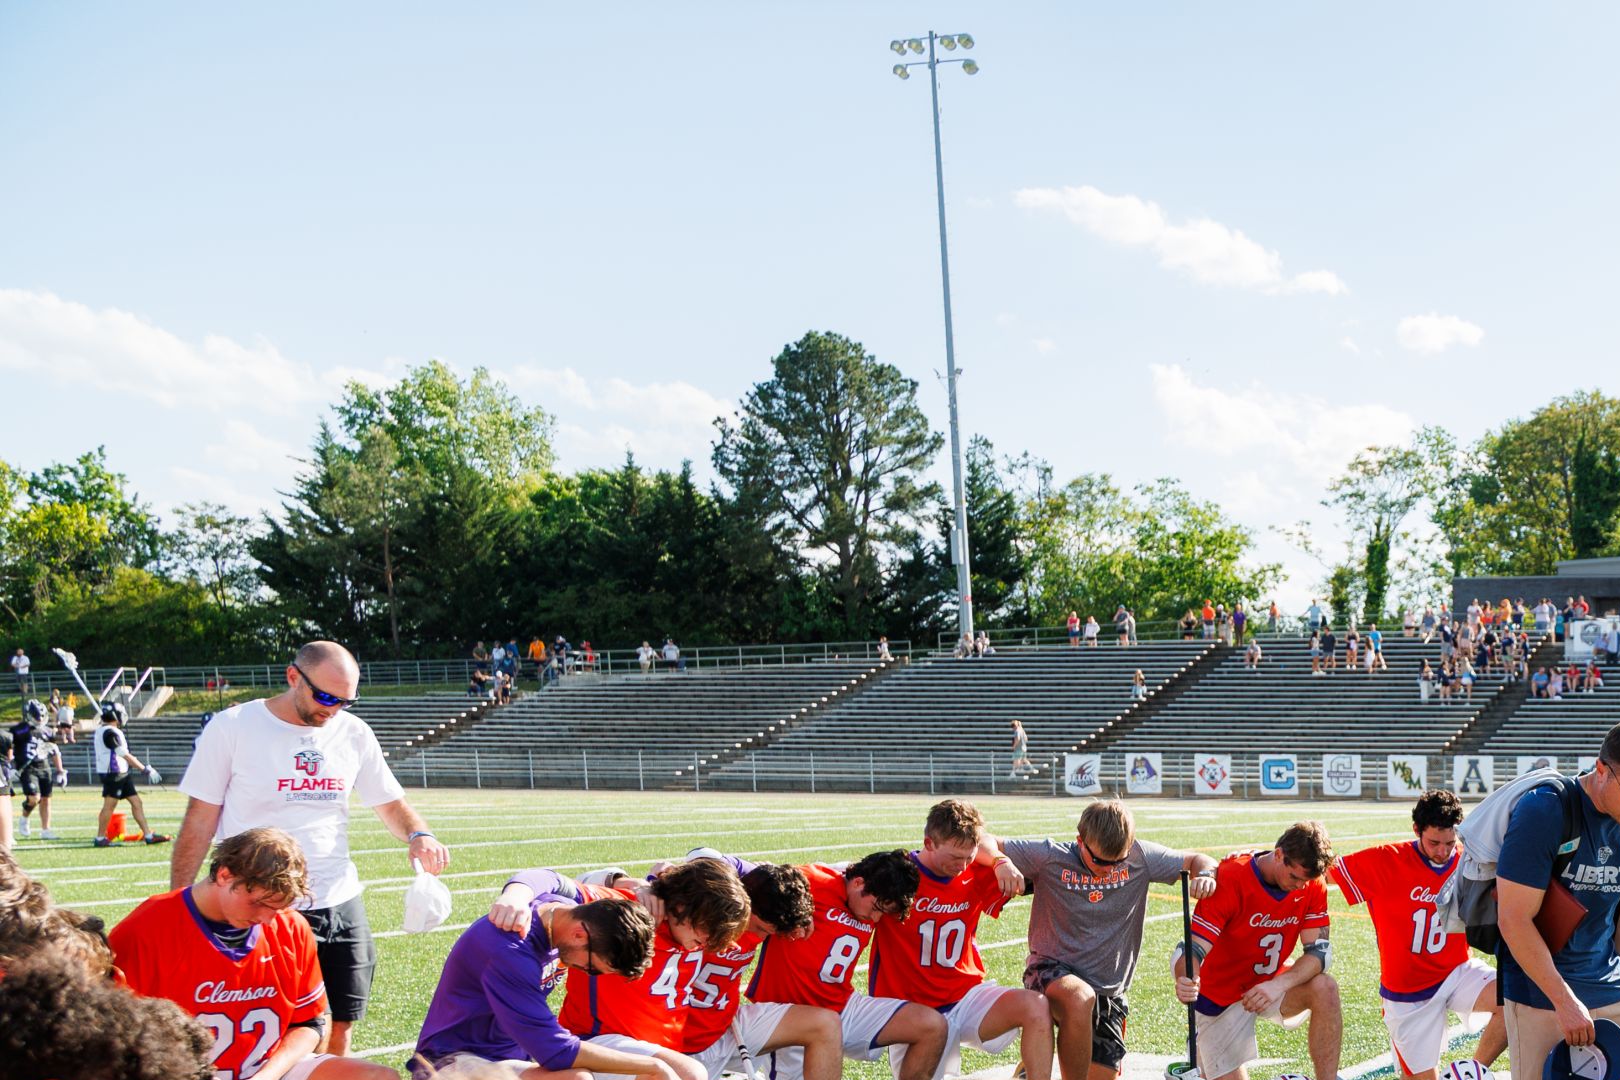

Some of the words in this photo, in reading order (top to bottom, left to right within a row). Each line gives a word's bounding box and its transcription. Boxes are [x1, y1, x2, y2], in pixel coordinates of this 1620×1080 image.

[277, 778, 345, 791] FLAMES
[1460, 759, 1487, 792] A
[914, 897, 970, 913] Clemson
[826, 908, 873, 934] Clemson
[1249, 912, 1300, 928] Clemson
[918, 918, 967, 968] 10
[1253, 933, 1283, 975] 3
[818, 933, 861, 984] 8
[194, 980, 278, 1004] Clemson
